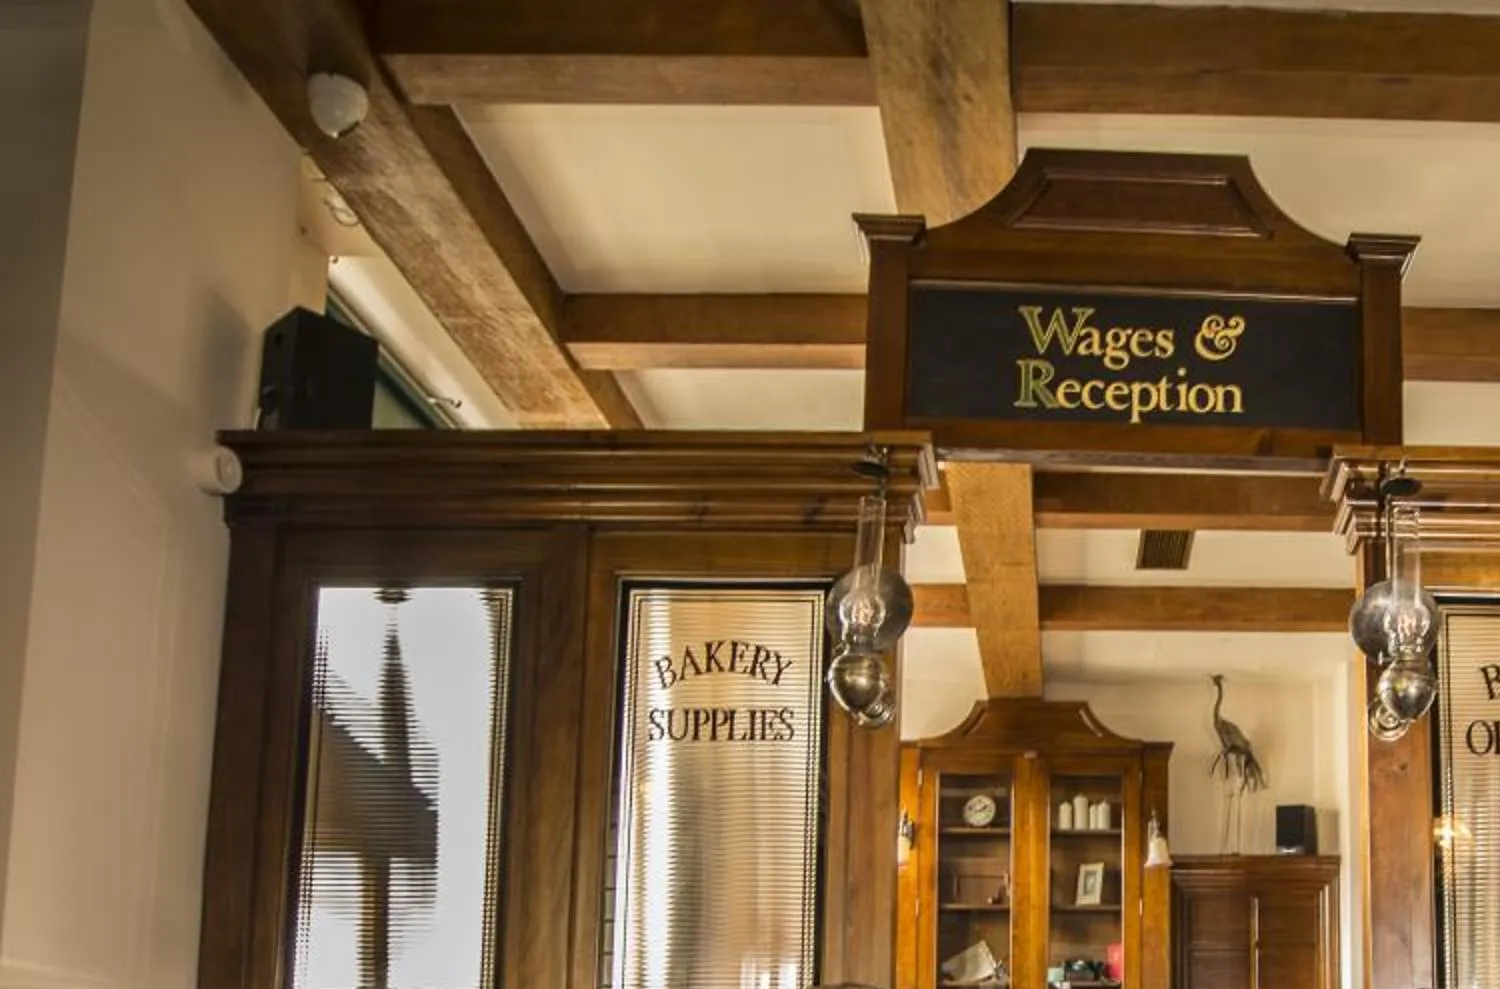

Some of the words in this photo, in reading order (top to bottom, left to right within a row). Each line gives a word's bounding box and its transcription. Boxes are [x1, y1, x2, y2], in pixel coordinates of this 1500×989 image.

[1018, 305, 1175, 370] Wages
[1194, 313, 1246, 361] &
[1013, 358, 1244, 424] Reception
[655, 639, 793, 689] BAKERY
[649, 707, 795, 741] SUPPLIES
